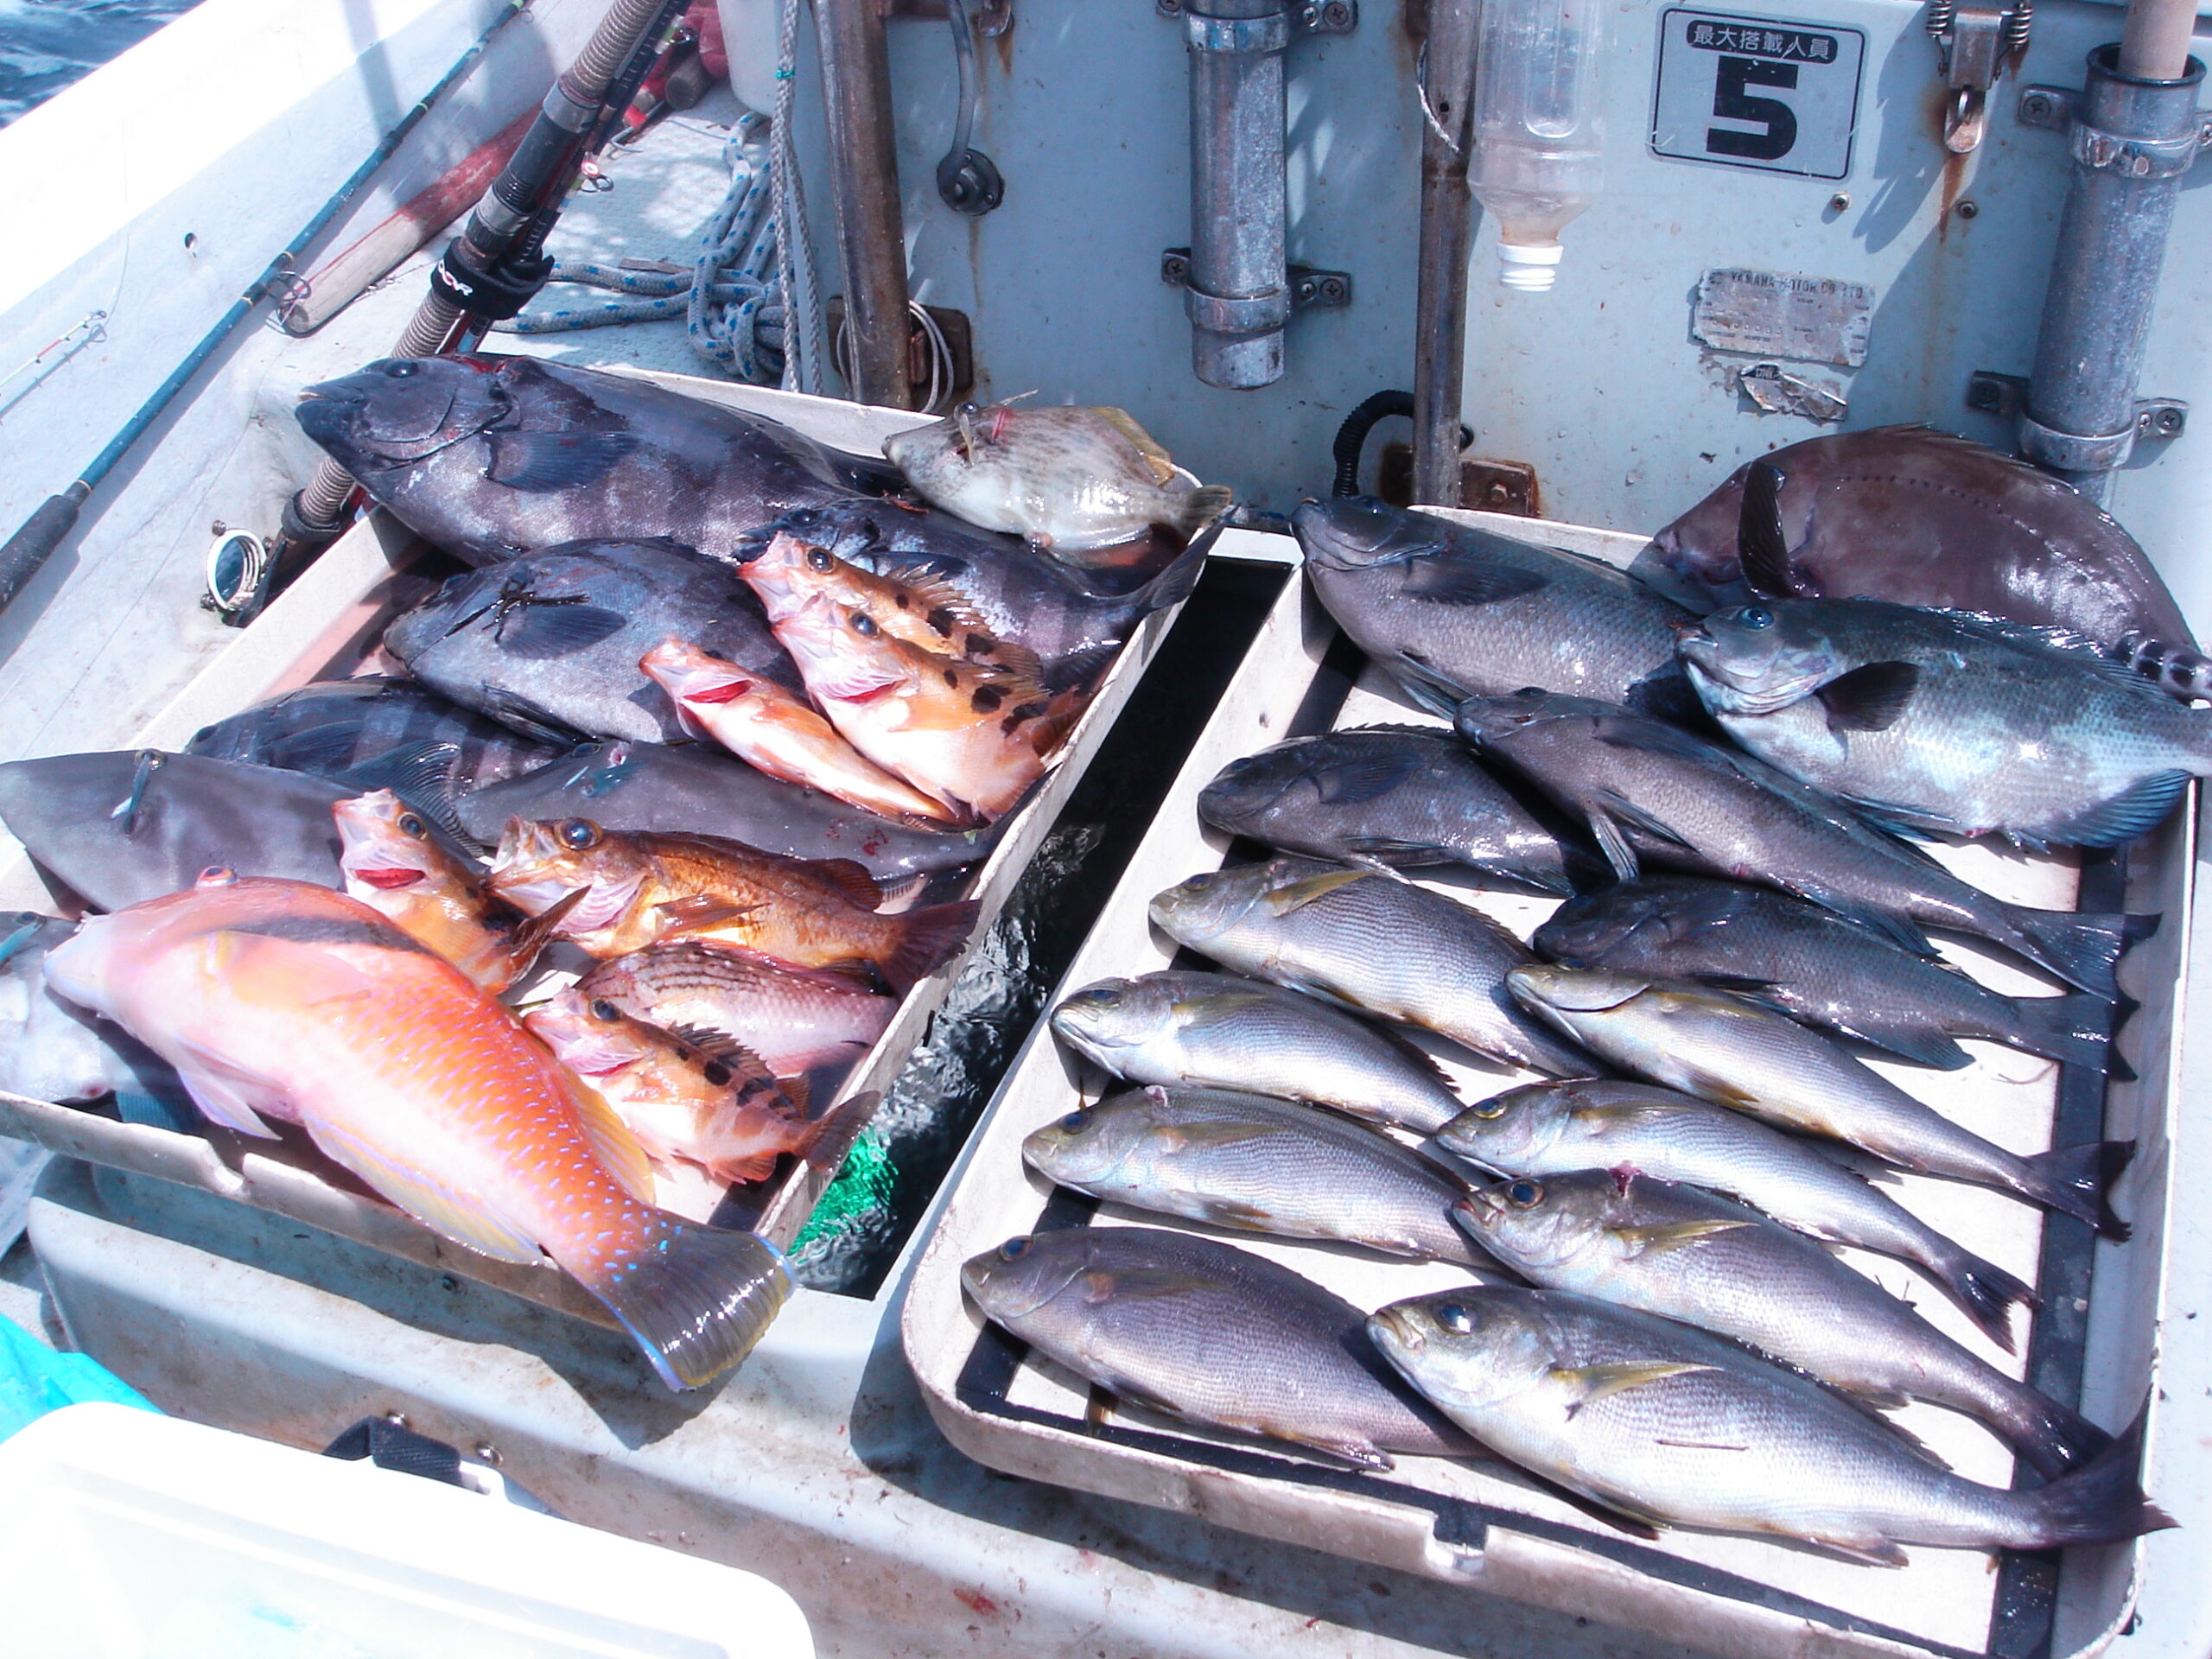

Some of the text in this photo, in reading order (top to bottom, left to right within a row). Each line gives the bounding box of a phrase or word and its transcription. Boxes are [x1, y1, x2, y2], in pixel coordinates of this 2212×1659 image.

[1694, 25, 1830, 60] 最大搭載人員
[1707, 55, 1799, 161] 5
